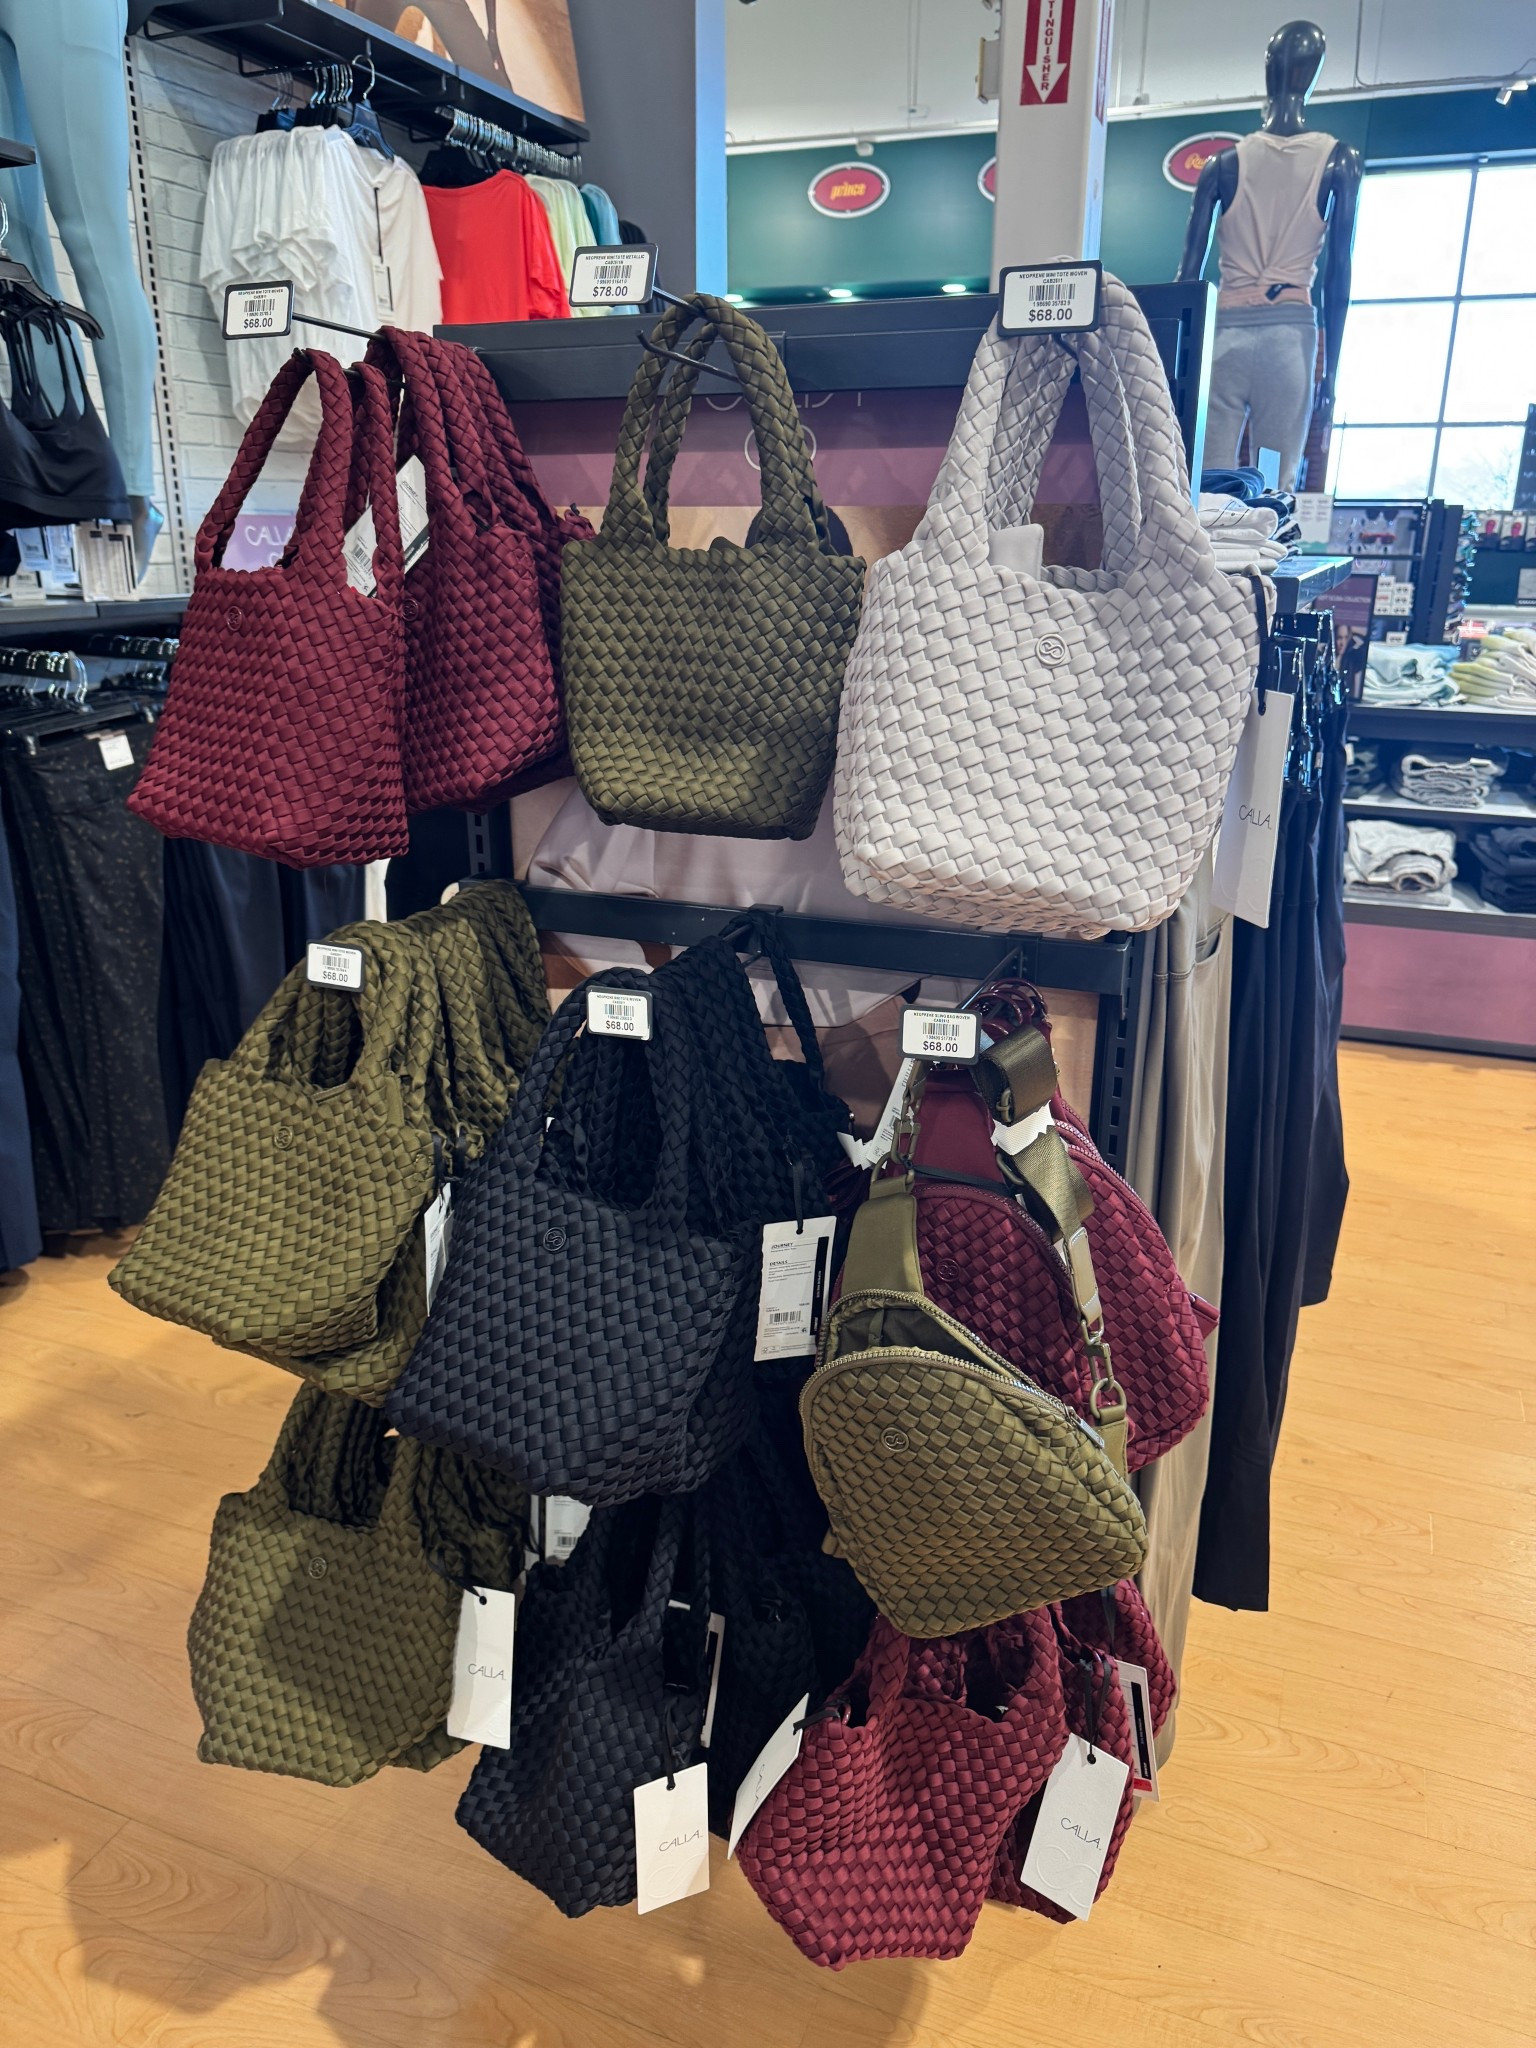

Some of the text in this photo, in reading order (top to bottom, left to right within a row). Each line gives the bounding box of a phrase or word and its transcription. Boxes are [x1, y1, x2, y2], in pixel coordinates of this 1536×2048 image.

[592, 286, 628, 298] $78.00
[1028, 308, 1073, 323] $68.00
[243, 317, 273, 329] $68.00
[1239, 804, 1271, 830] CALIA
[322, 970, 349, 983] $68.00
[605, 1020, 635, 1032] $68.00
[922, 1040, 958, 1053] $68.00
[771, 1242, 794, 1250] JOURNEY
[468, 1663, 505, 1681] CALIA
[1061, 1817, 1101, 1849] CALIA
[659, 1829, 700, 1852] CALIA
